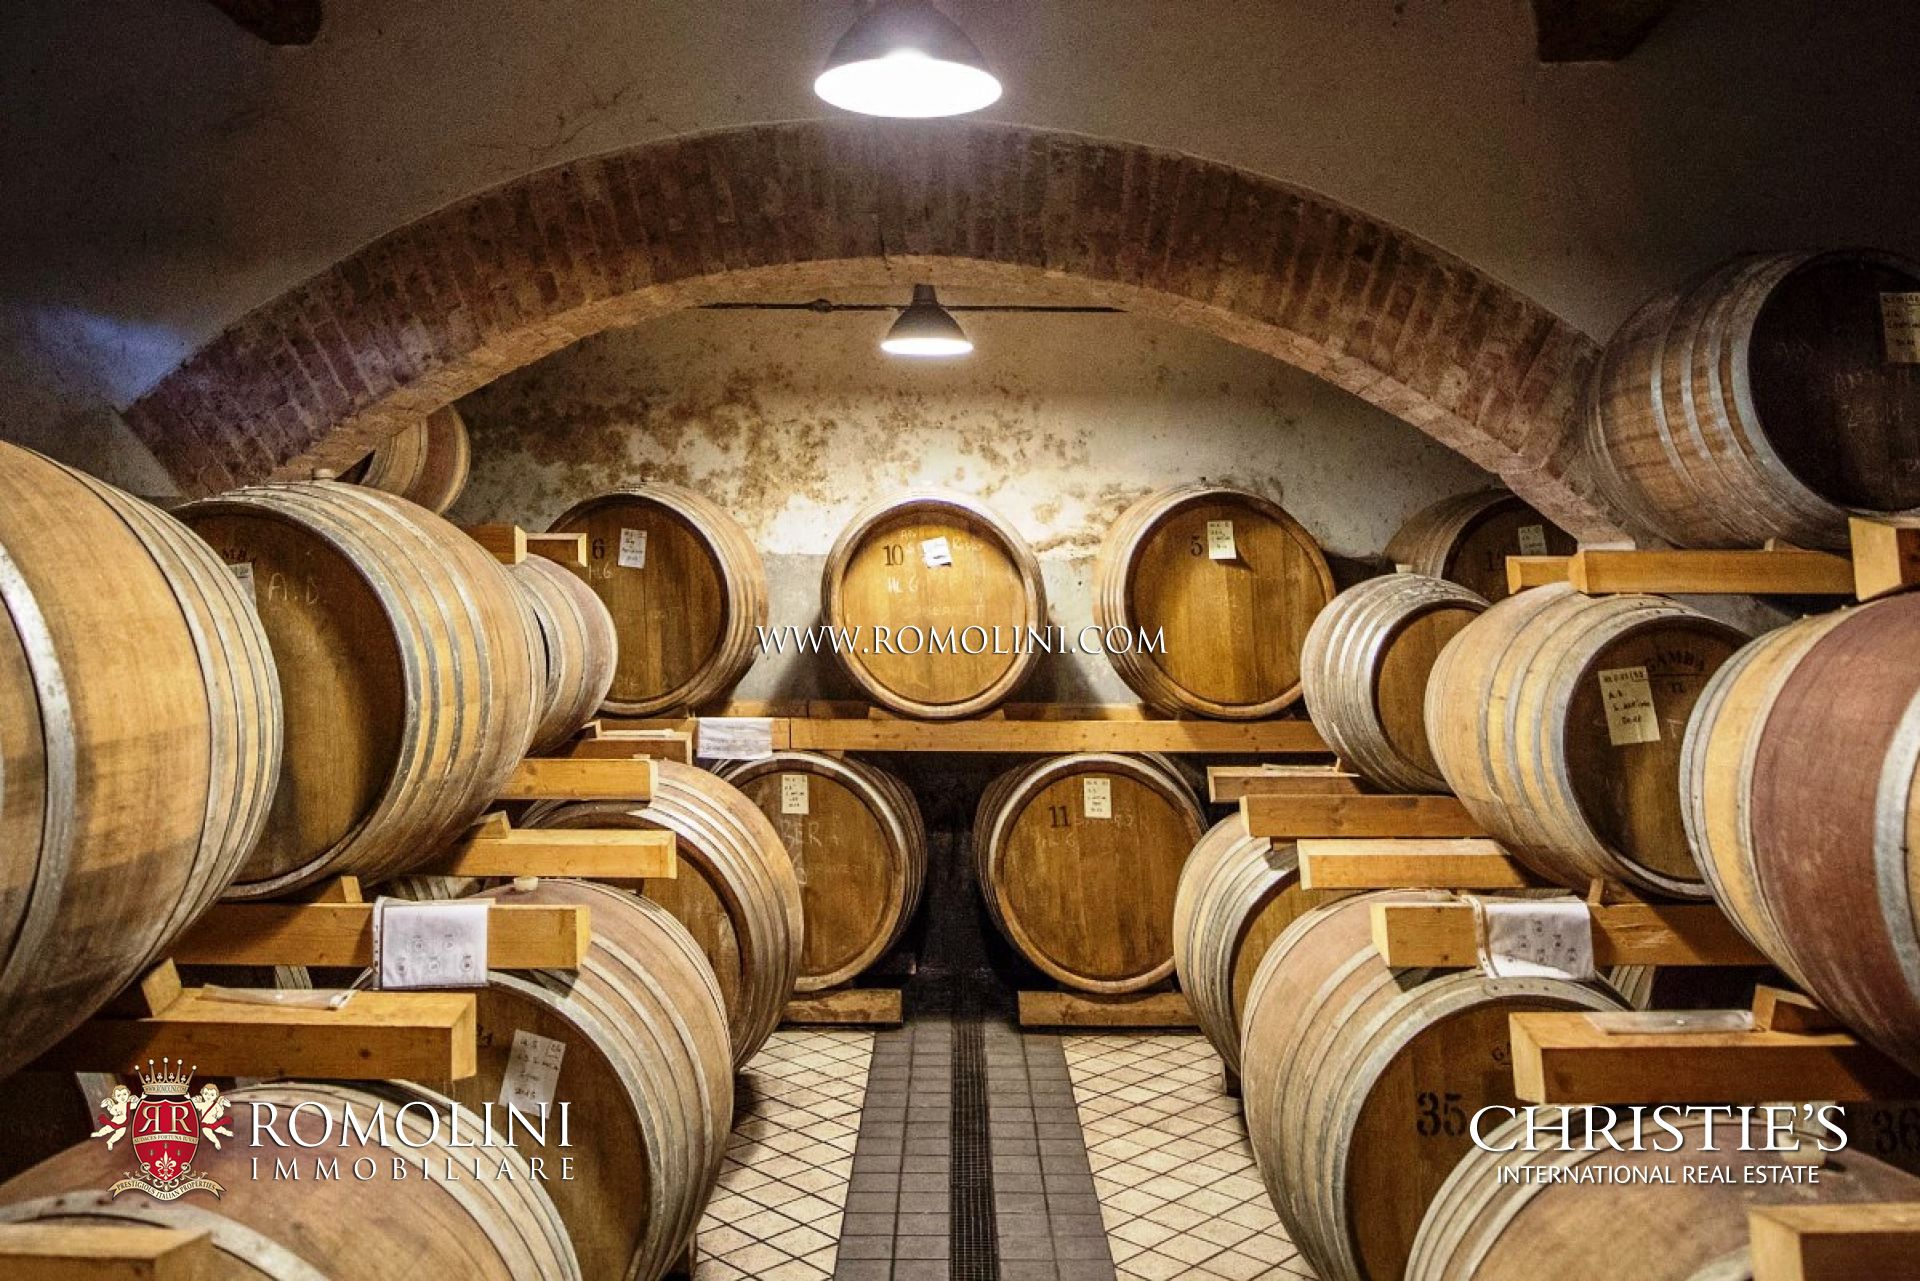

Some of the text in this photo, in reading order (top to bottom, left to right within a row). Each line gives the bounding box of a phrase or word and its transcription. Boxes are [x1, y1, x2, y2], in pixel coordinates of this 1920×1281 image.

[882, 544, 904, 566] 10
[1048, 804, 1071, 829] 11
[1416, 1091, 1468, 1137] 35
